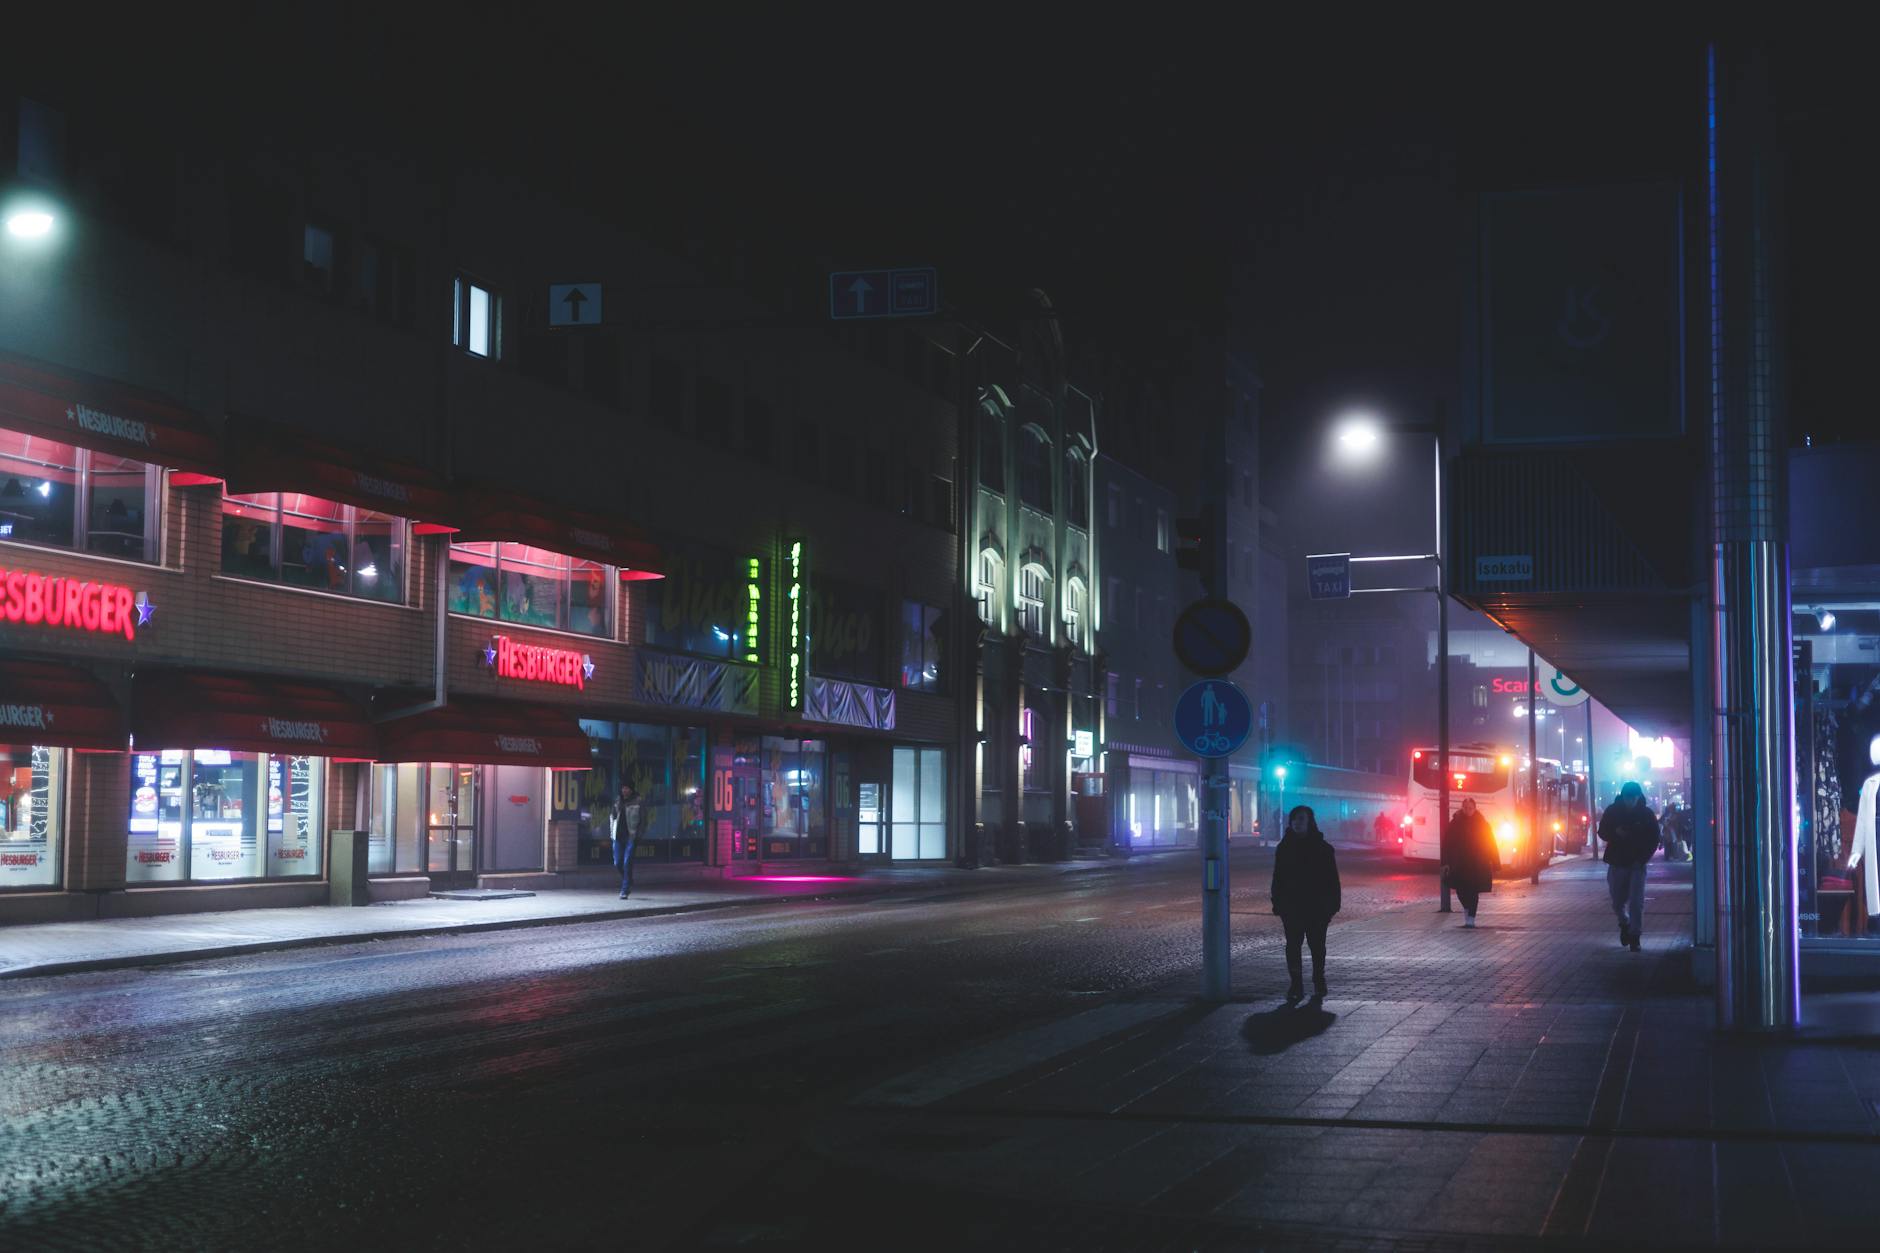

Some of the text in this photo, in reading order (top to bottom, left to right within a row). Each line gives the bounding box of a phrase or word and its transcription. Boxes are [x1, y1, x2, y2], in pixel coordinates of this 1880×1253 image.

[76, 404, 149, 446] HESBURGER
[1316, 581, 1342, 593] TAXI
[1478, 560, 1530, 575] Isokatu
[497, 633, 584, 691] HESBURGER
[790, 653, 799, 707] Disco
[268, 716, 323, 743] HESBURGER
[714, 769, 733, 812] 06
